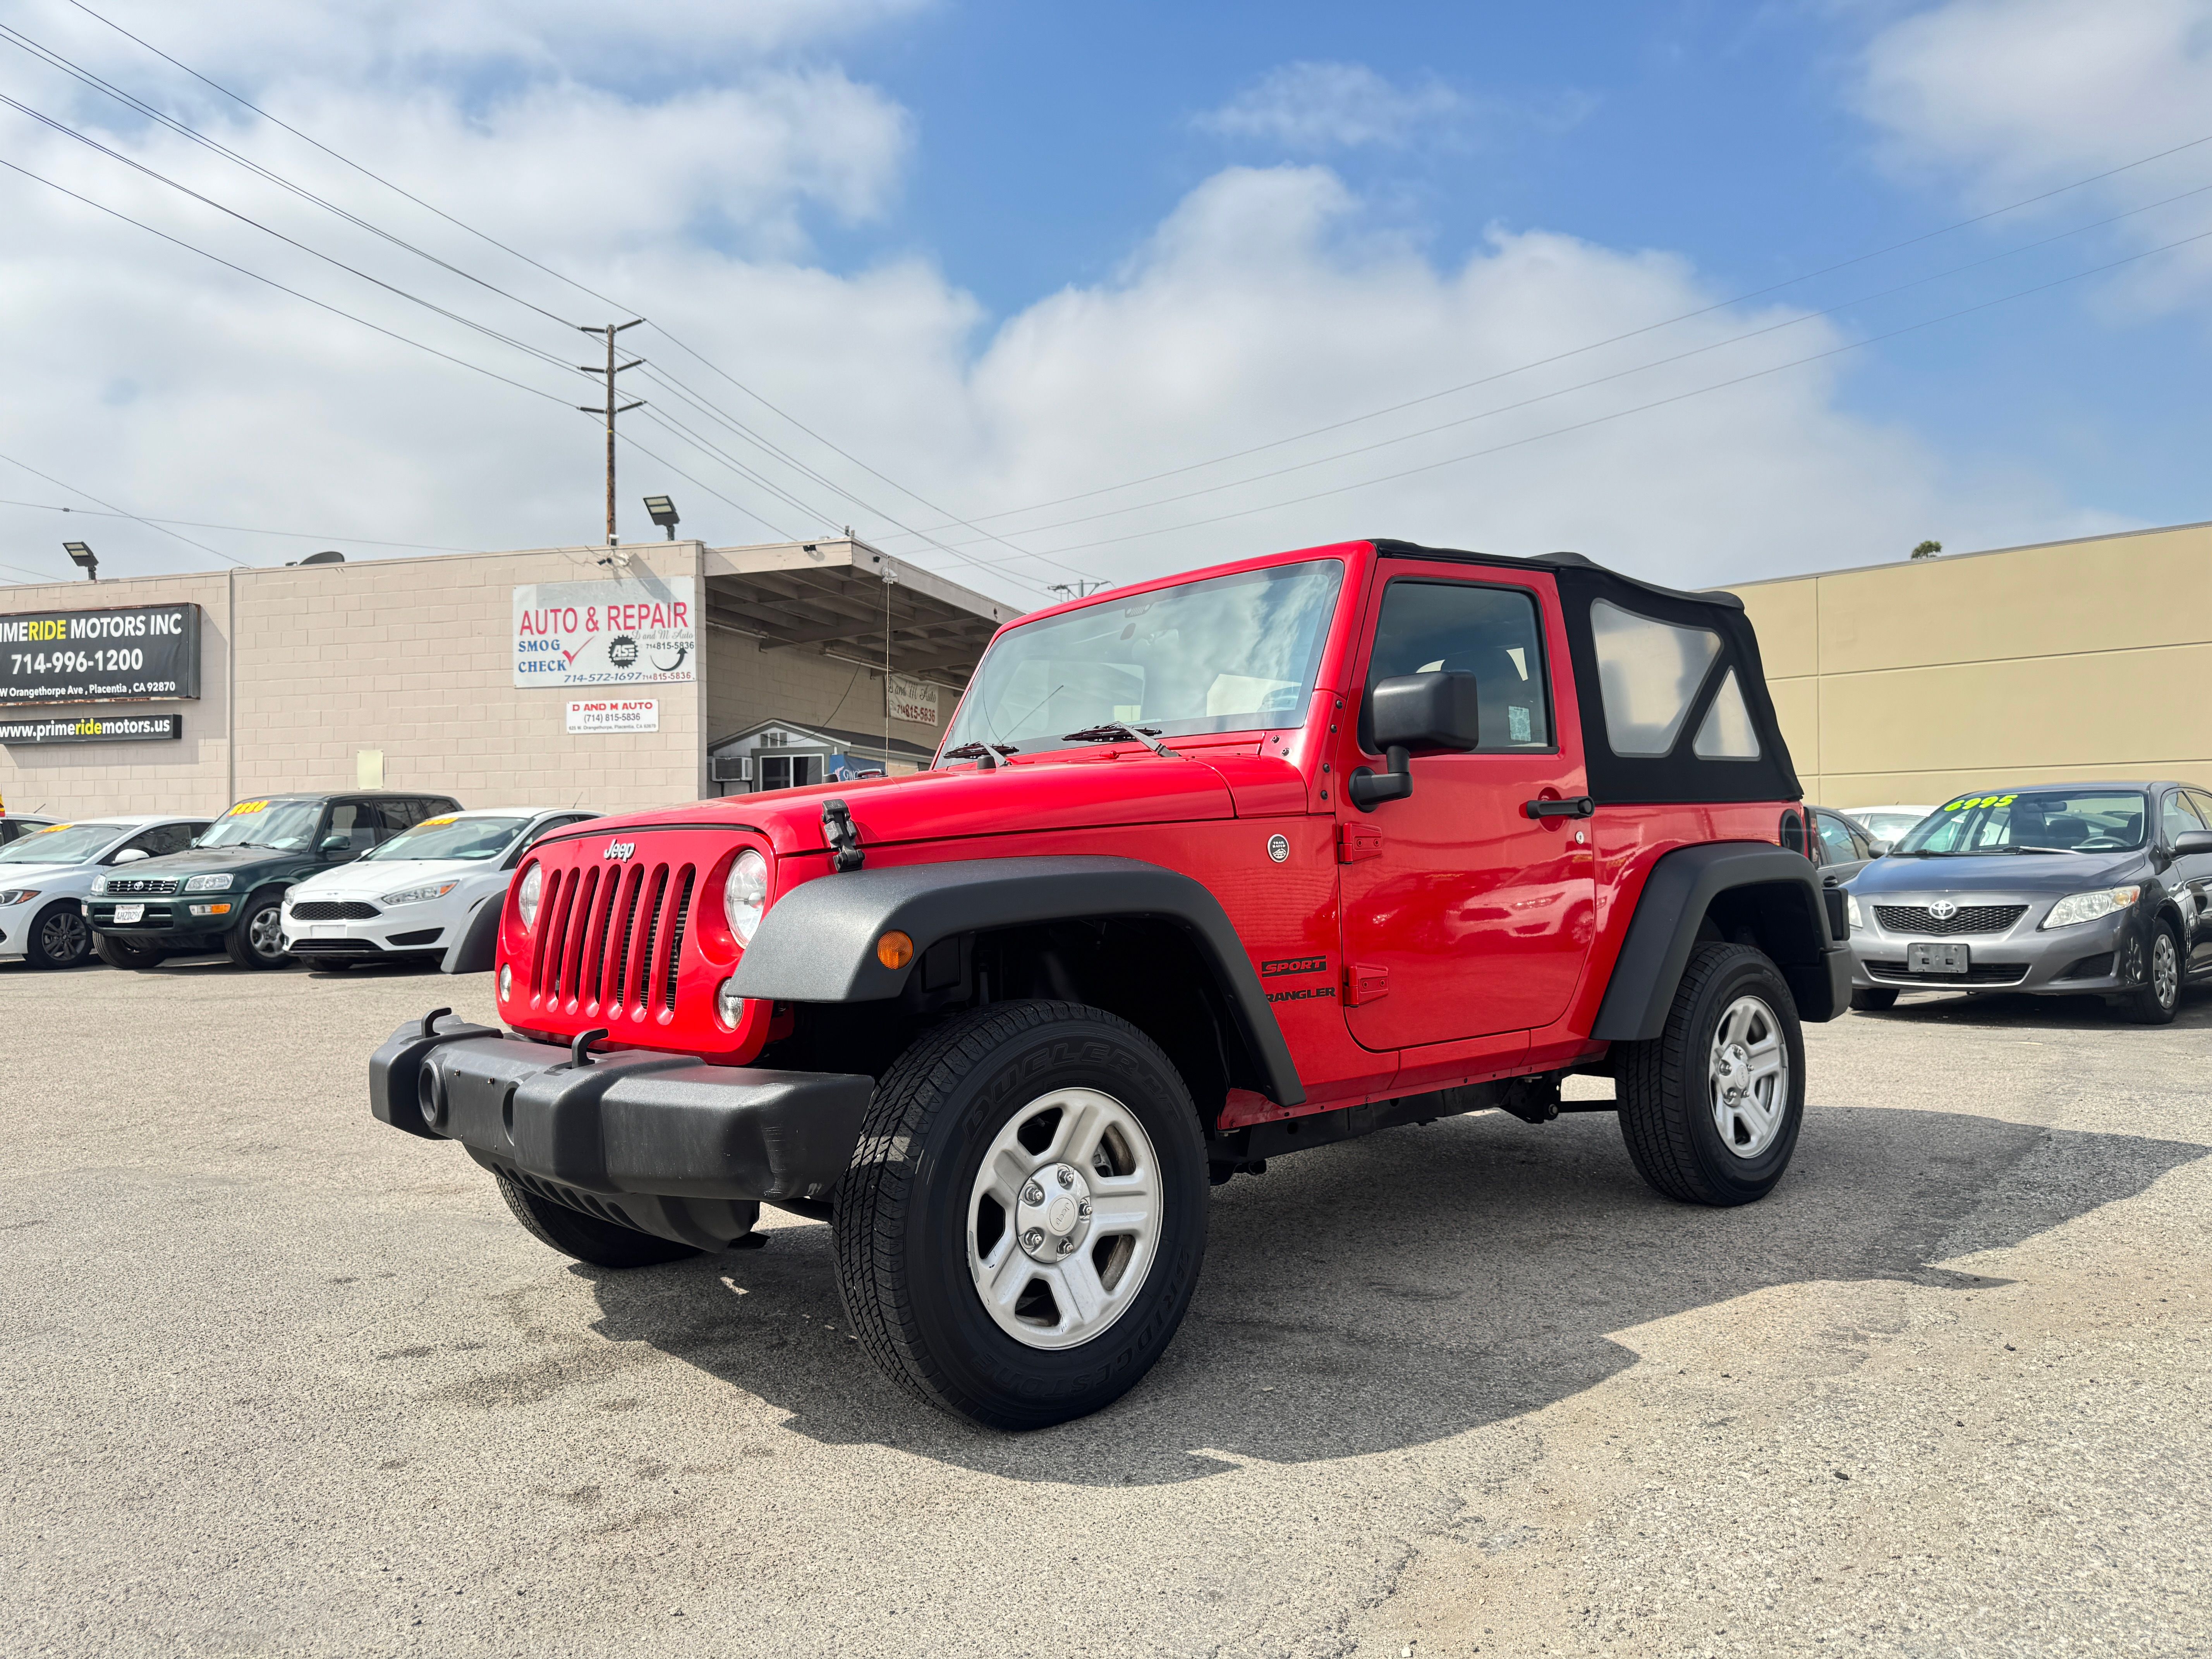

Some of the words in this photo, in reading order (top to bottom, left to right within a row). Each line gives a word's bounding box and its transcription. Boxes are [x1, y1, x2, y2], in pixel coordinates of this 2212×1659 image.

[70, 615, 146, 639] MOTORS
[150, 613, 182, 635] INC
[520, 607, 578, 635] AUTO
[586, 606, 599, 632] &
[608, 602, 689, 631] REPAIR
[632, 630, 641, 640] D
[642, 630, 655, 639] and
[658, 630, 669, 639] M
[672, 629, 693, 639] Auto
[518, 639, 560, 652] SMOG
[612, 644, 635, 657] ASE
[11, 649, 143, 675] 714-996-1200
[518, 660, 567, 673] CHECK
[564, 672, 642, 683] 714-572-1697
[0, 688, 8, 697] W
[9, 685, 66, 699] Orangethorpe
[89, 683, 127, 694] Placentia
[133, 683, 146, 692] CA
[147, 682, 175, 691] 92870
[895, 681, 907, 696] and
[909, 683, 918, 699] M
[920, 685, 936, 703] Auto
[622, 702, 653, 710] AUTO
[584, 714, 603, 723] (714)
[605, 713, 641, 721] 815-5836
[0, 718, 170, 741] www.primeridemotors.us
[1944, 795, 2018, 811] 6995
[604, 839, 635, 863] Jeep
[1262, 959, 1326, 974] SPORT
[962, 1042, 1139, 1143] DUELER
[1056, 1202, 1070, 1225] Jeep
[971, 1245, 1190, 1398] BRIDGESTONE
